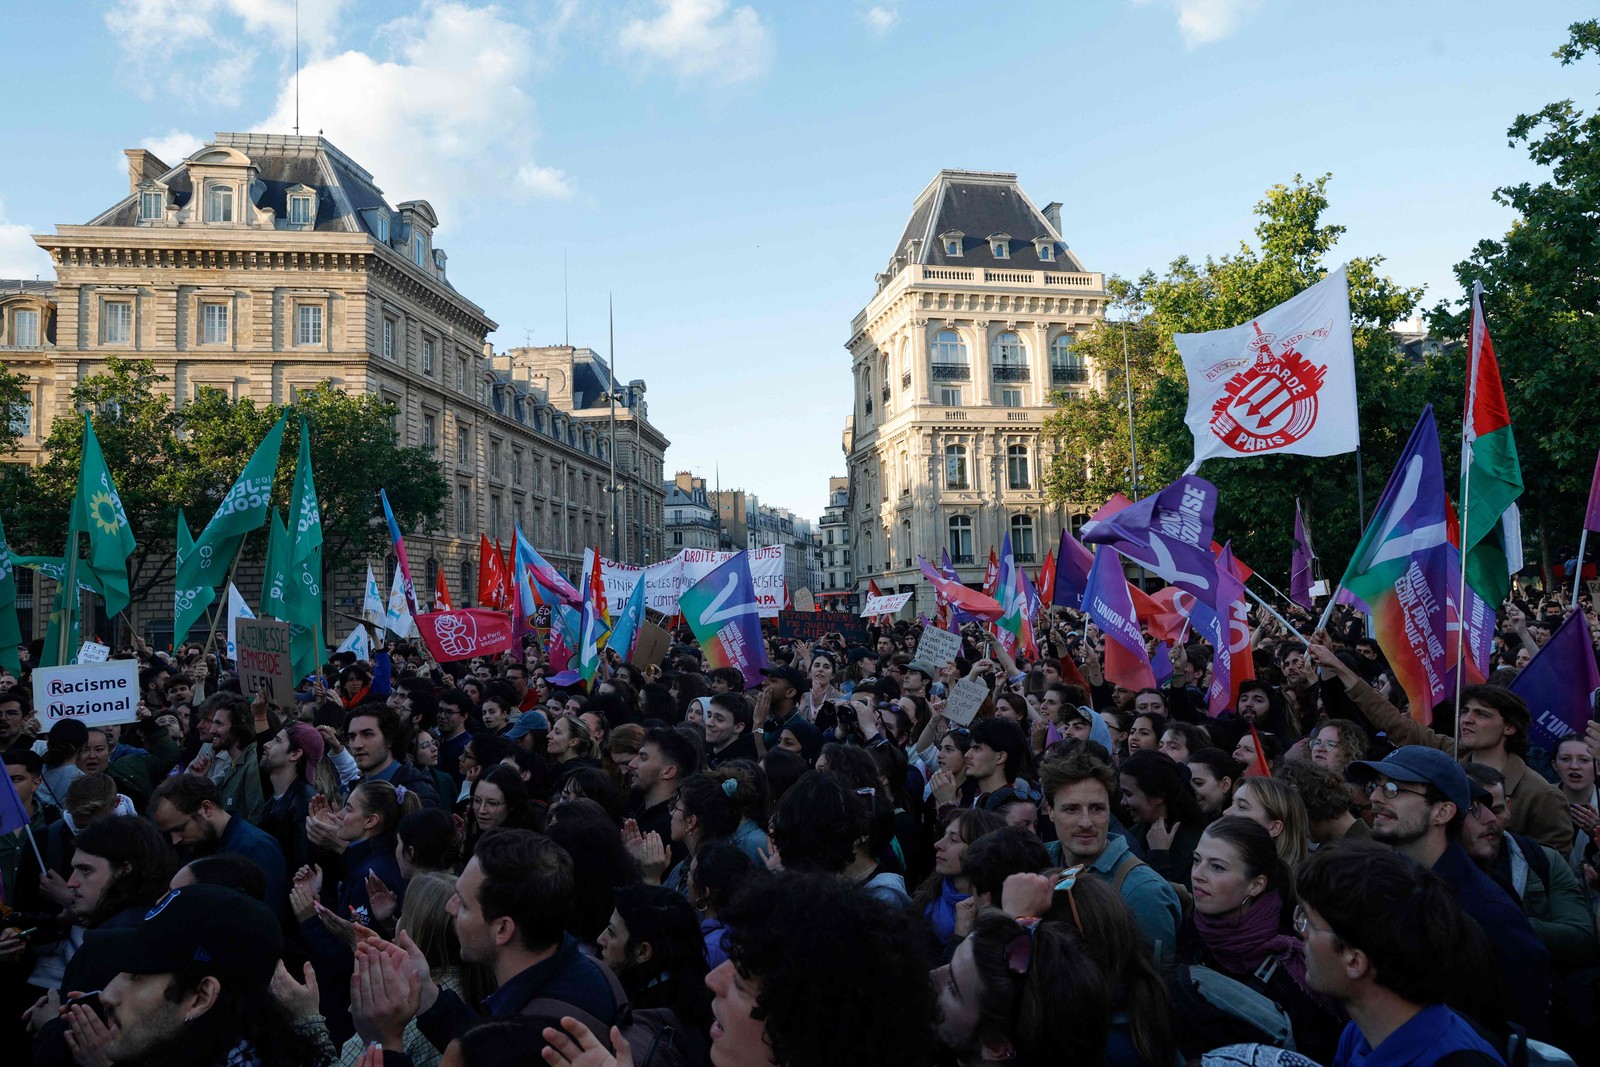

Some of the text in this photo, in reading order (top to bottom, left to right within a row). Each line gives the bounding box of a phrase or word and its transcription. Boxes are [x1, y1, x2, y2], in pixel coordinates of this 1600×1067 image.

[1252, 335, 1272, 349] NEC
[1234, 432, 1286, 451] PARIS
[754, 546, 782, 560] LUTTES
[753, 574, 784, 588] ACISTES
[1409, 560, 1440, 618] NOUVELLE
[1093, 595, 1126, 629] L'UNION
[480, 635, 506, 647] socialiste
[487, 632, 501, 640] Parti
[241, 648, 282, 676] EMMERDE
[51, 678, 127, 695] Racisme
[50, 696, 130, 717] Nazional
